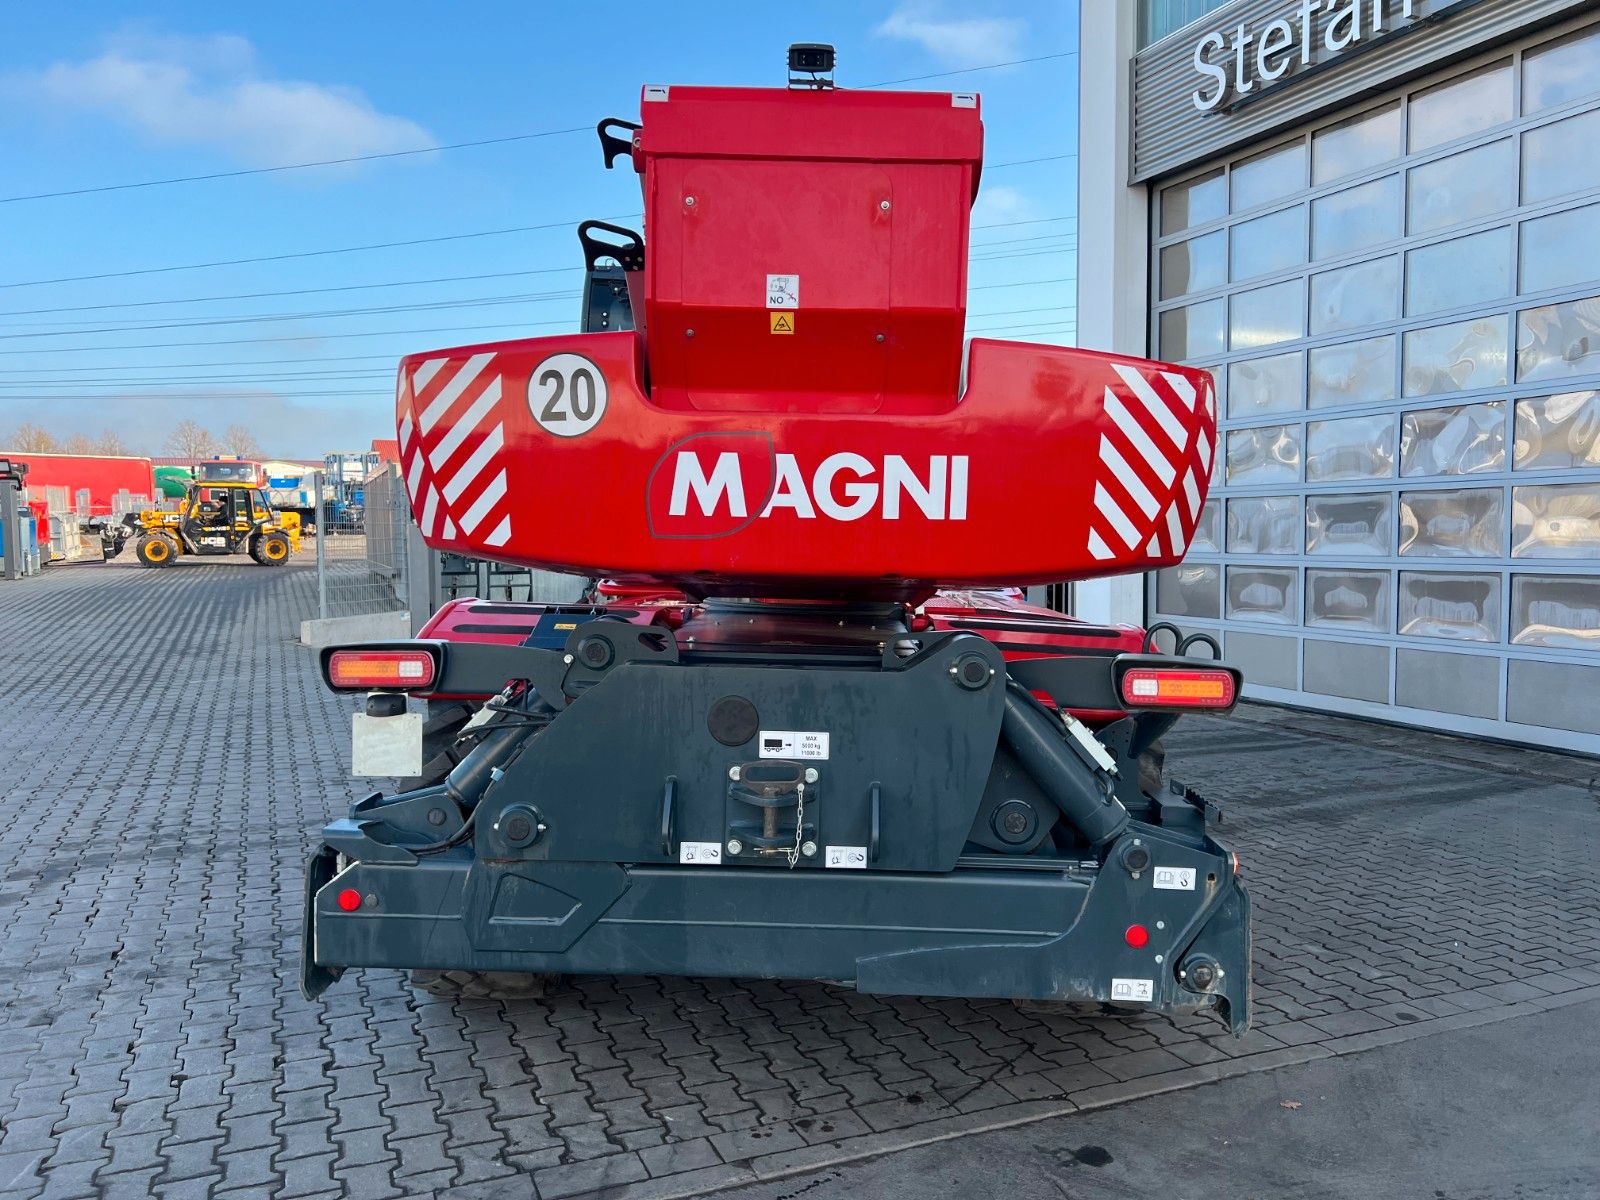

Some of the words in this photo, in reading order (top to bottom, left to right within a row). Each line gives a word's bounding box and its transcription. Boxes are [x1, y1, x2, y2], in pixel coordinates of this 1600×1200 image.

[769, 296, 784, 304] NO
[539, 368, 596, 421] 20
[668, 451, 969, 521] MAGNI
[201, 537, 227, 545] JCB
